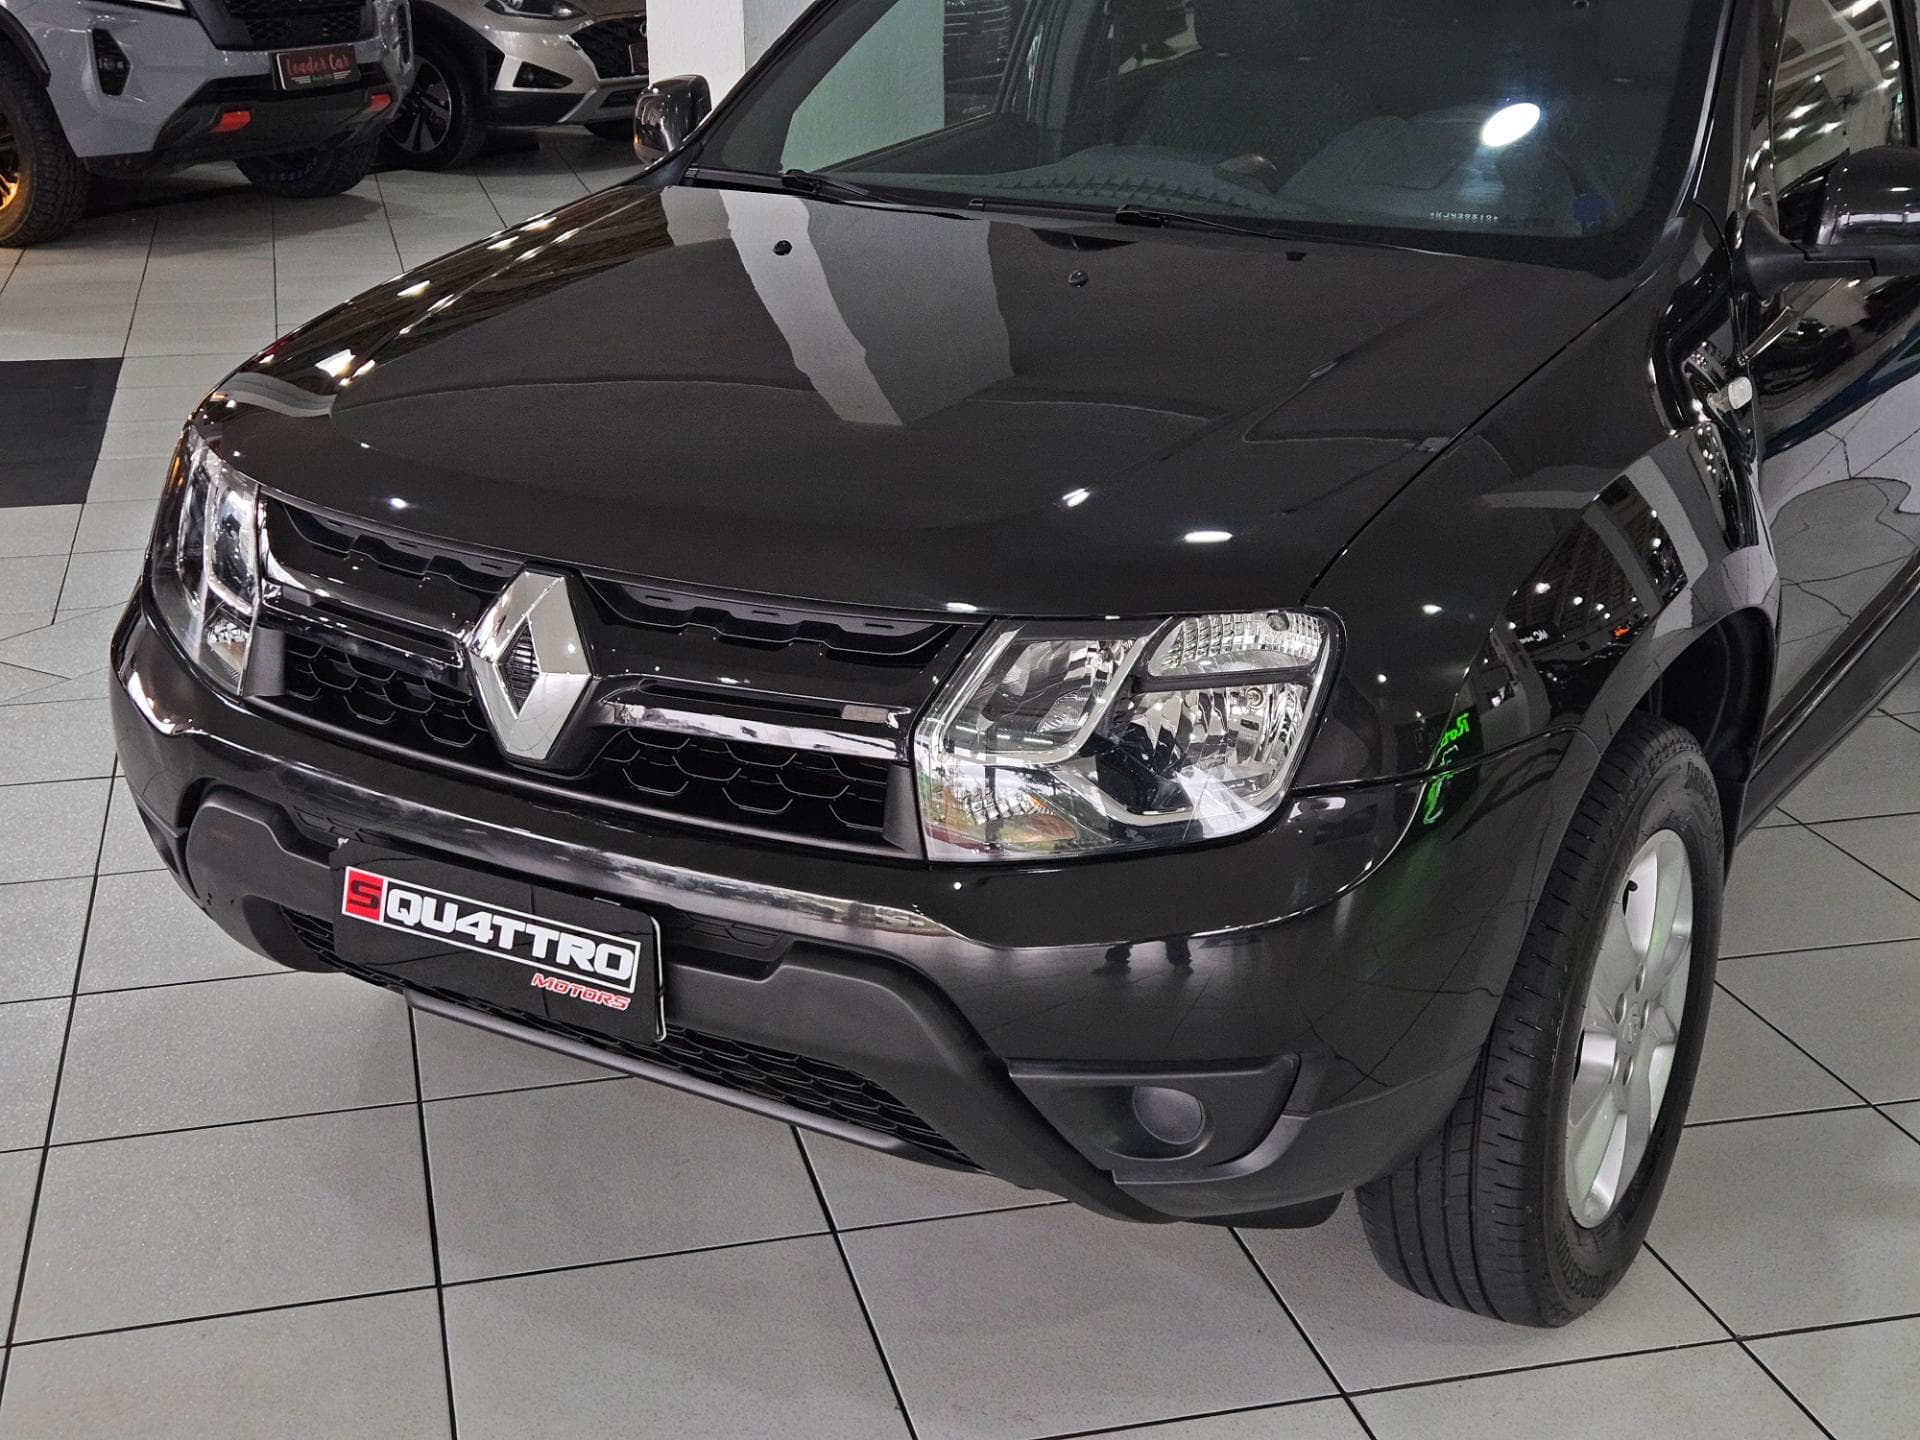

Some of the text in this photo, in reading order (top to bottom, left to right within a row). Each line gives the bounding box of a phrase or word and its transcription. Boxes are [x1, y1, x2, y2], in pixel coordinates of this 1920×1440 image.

[286, 53, 349, 74] Leader Car
[531, 973, 631, 1011] MOTORS
